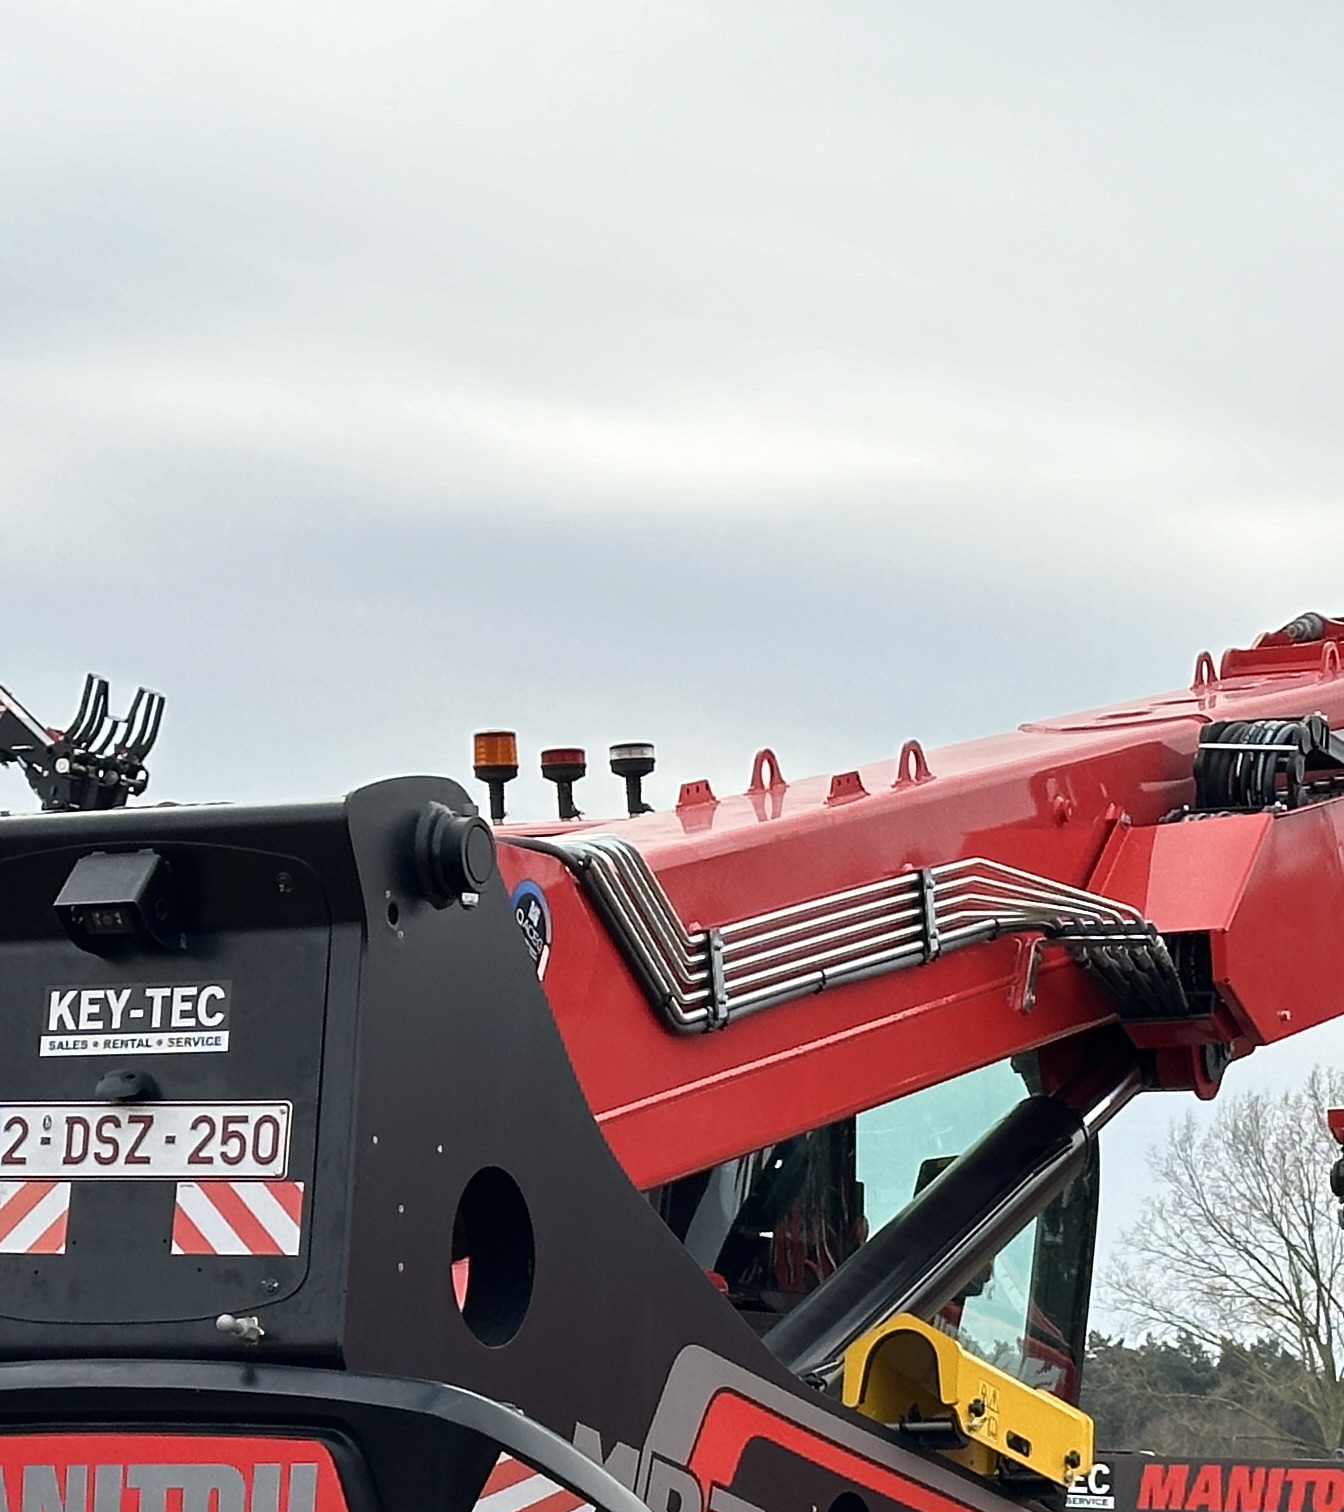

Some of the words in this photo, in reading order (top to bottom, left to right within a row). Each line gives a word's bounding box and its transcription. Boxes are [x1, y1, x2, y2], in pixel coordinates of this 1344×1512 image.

[48, 985, 226, 1031] KEY-TEC
[48, 1039, 89, 1051] SALES
[103, 1038, 153, 1050] RENTAL
[166, 1036, 222, 1048] SERVICE
